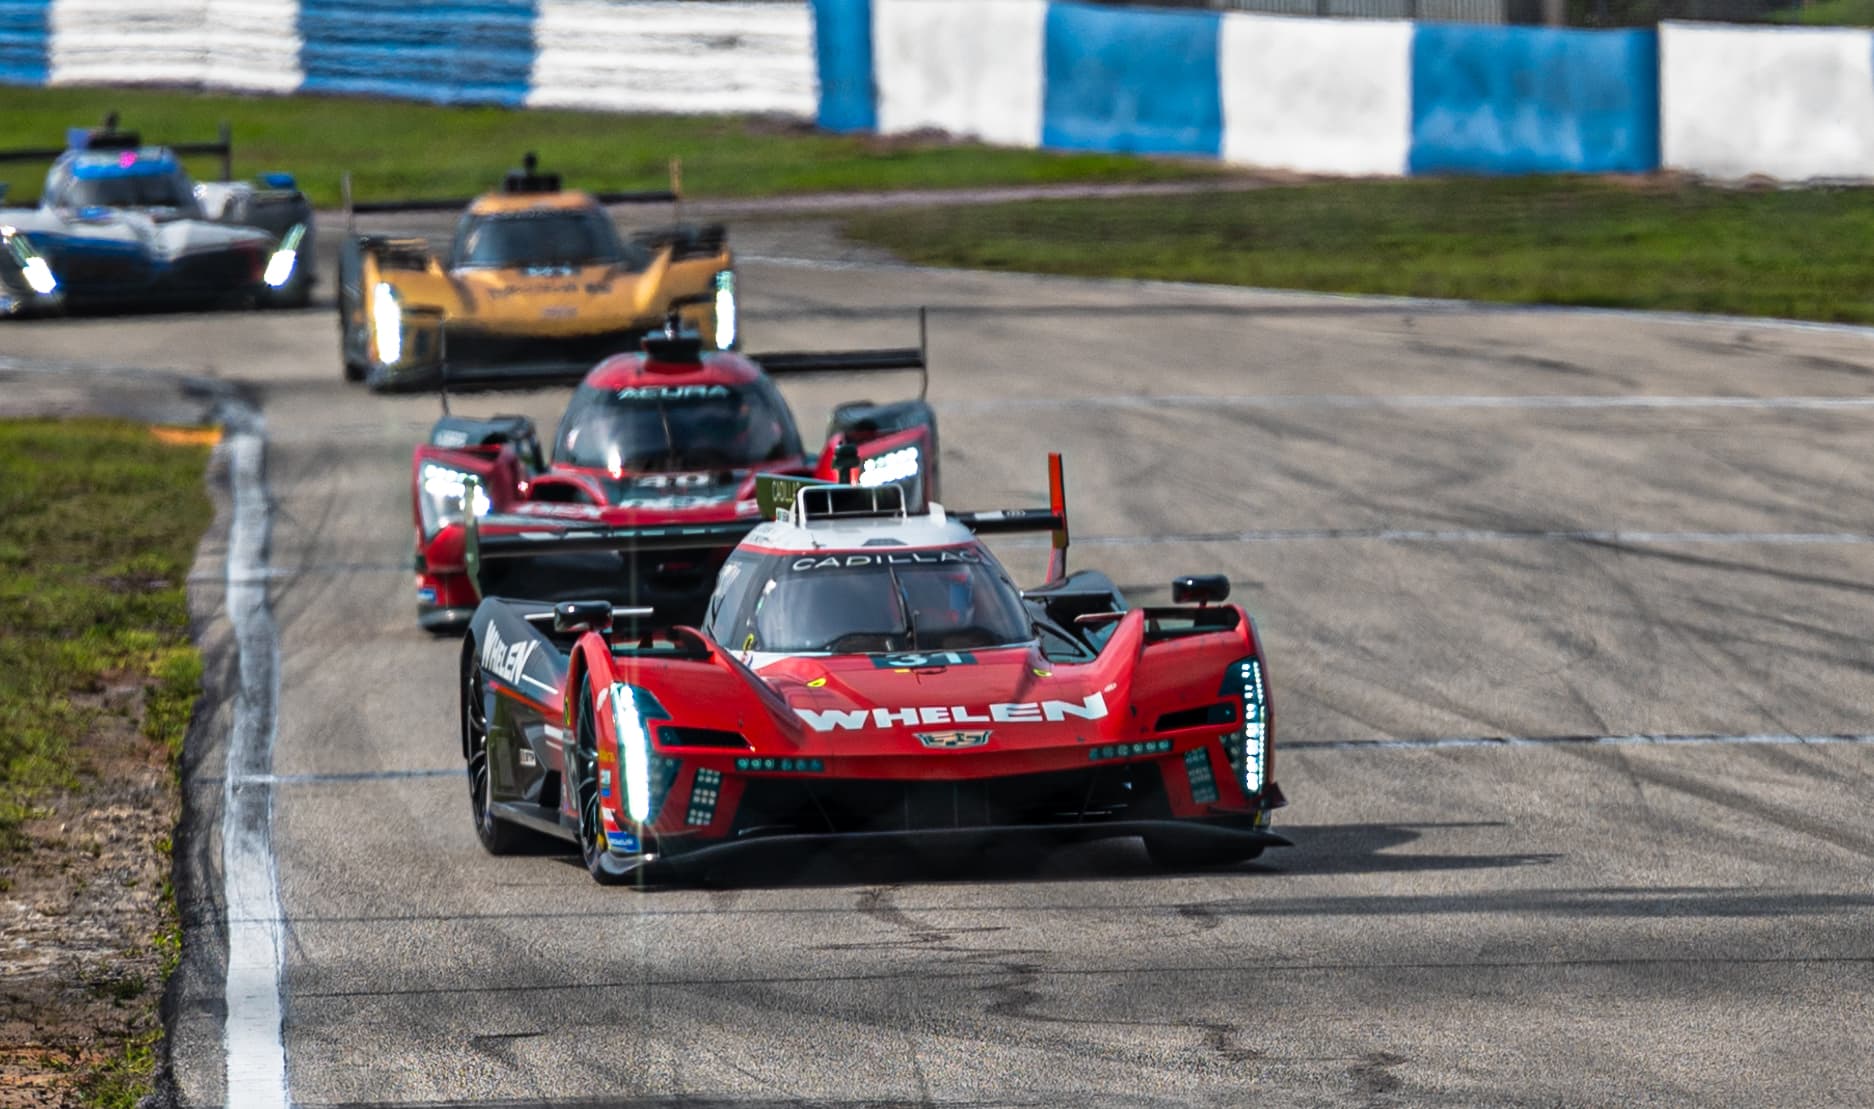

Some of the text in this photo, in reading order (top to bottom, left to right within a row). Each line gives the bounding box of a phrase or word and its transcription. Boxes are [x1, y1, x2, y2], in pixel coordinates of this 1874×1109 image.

[618, 384, 729, 401] ACURA
[792, 551, 980, 572] CADILLAC
[481, 619, 541, 686] WHELEN
[885, 651, 962, 667] 31
[792, 690, 1108, 732] WHELEN
